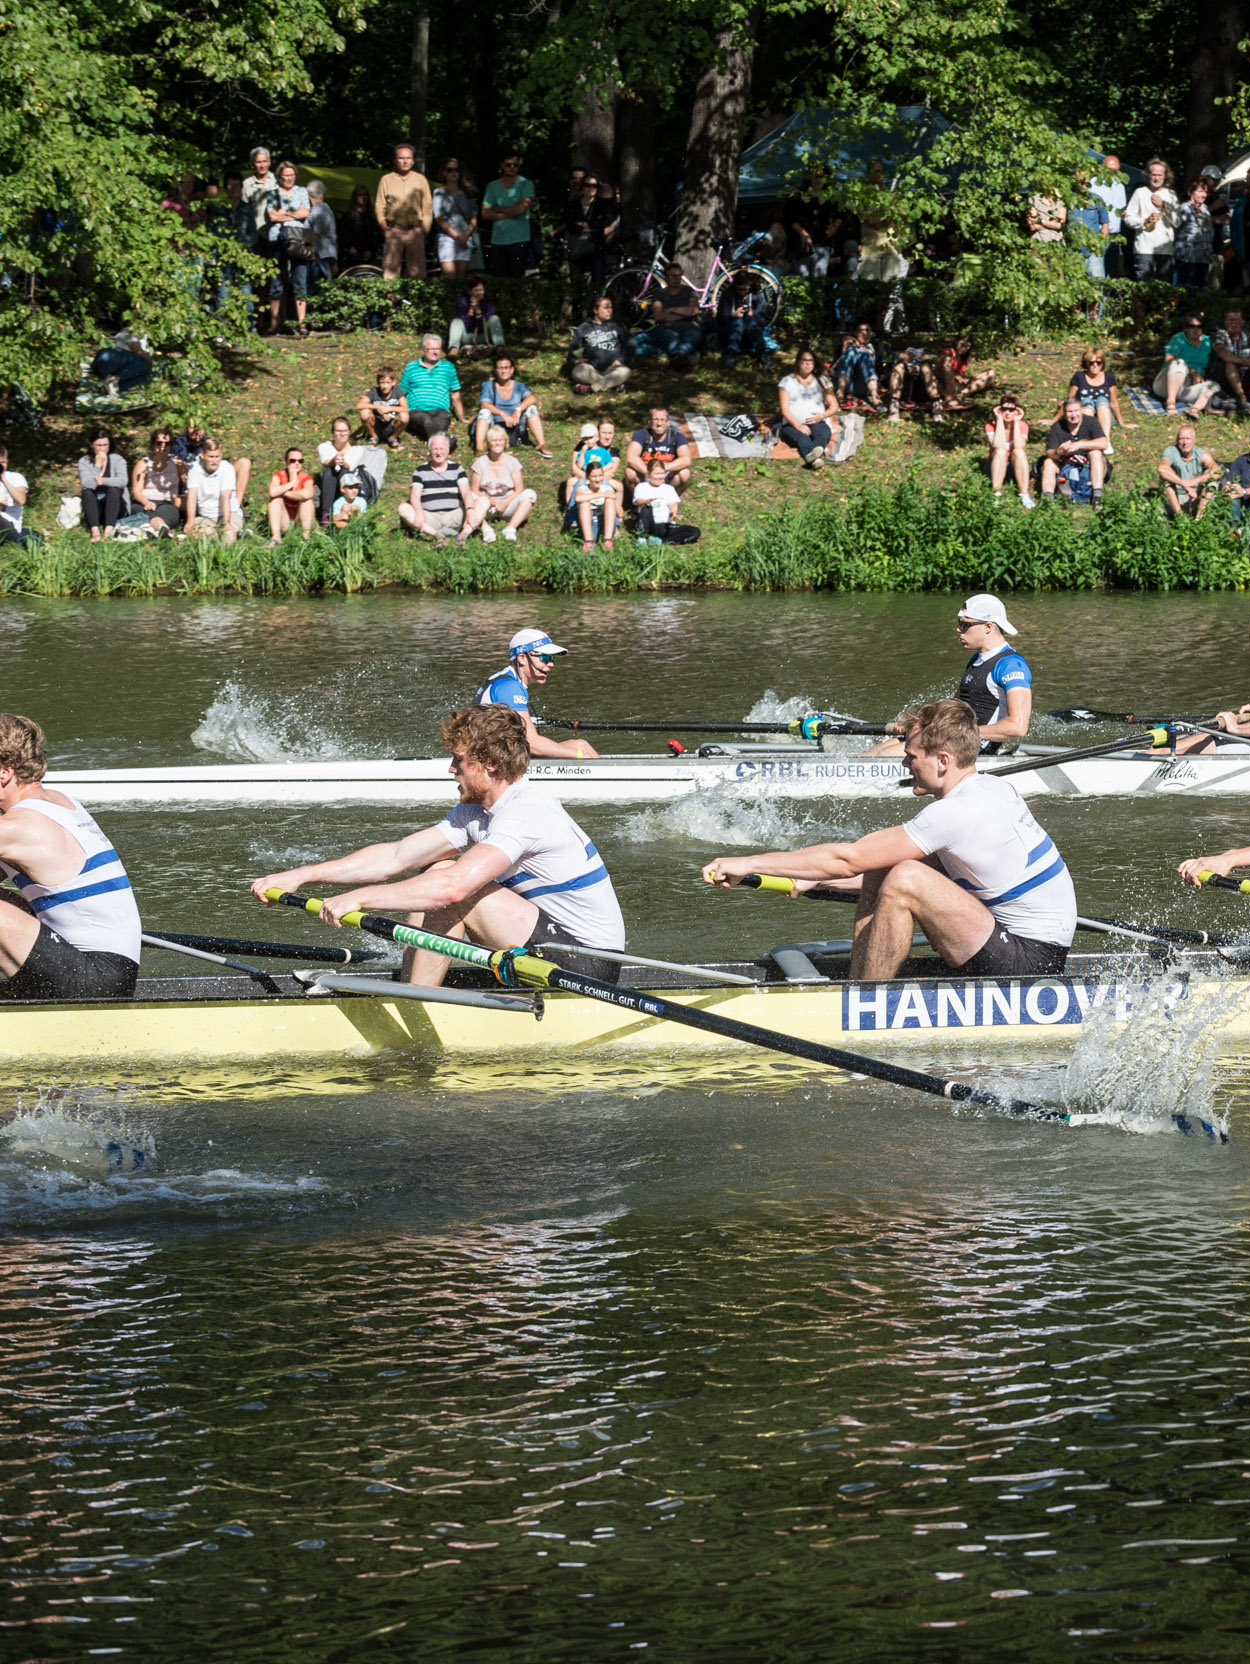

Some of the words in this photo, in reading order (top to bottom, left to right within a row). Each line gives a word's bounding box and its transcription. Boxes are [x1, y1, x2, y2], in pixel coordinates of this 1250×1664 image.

[557, 766, 591, 775] Minden
[761, 761, 808, 777] RBL
[1149, 761, 1198, 780] Melitta
[394, 926, 488, 966] HACKEROTT.de
[558, 979, 583, 993] STARK.
[584, 985, 618, 1003] SCHNELL.
[618, 996, 636, 1008] GUT.
[644, 1002, 659, 1013] RBL
